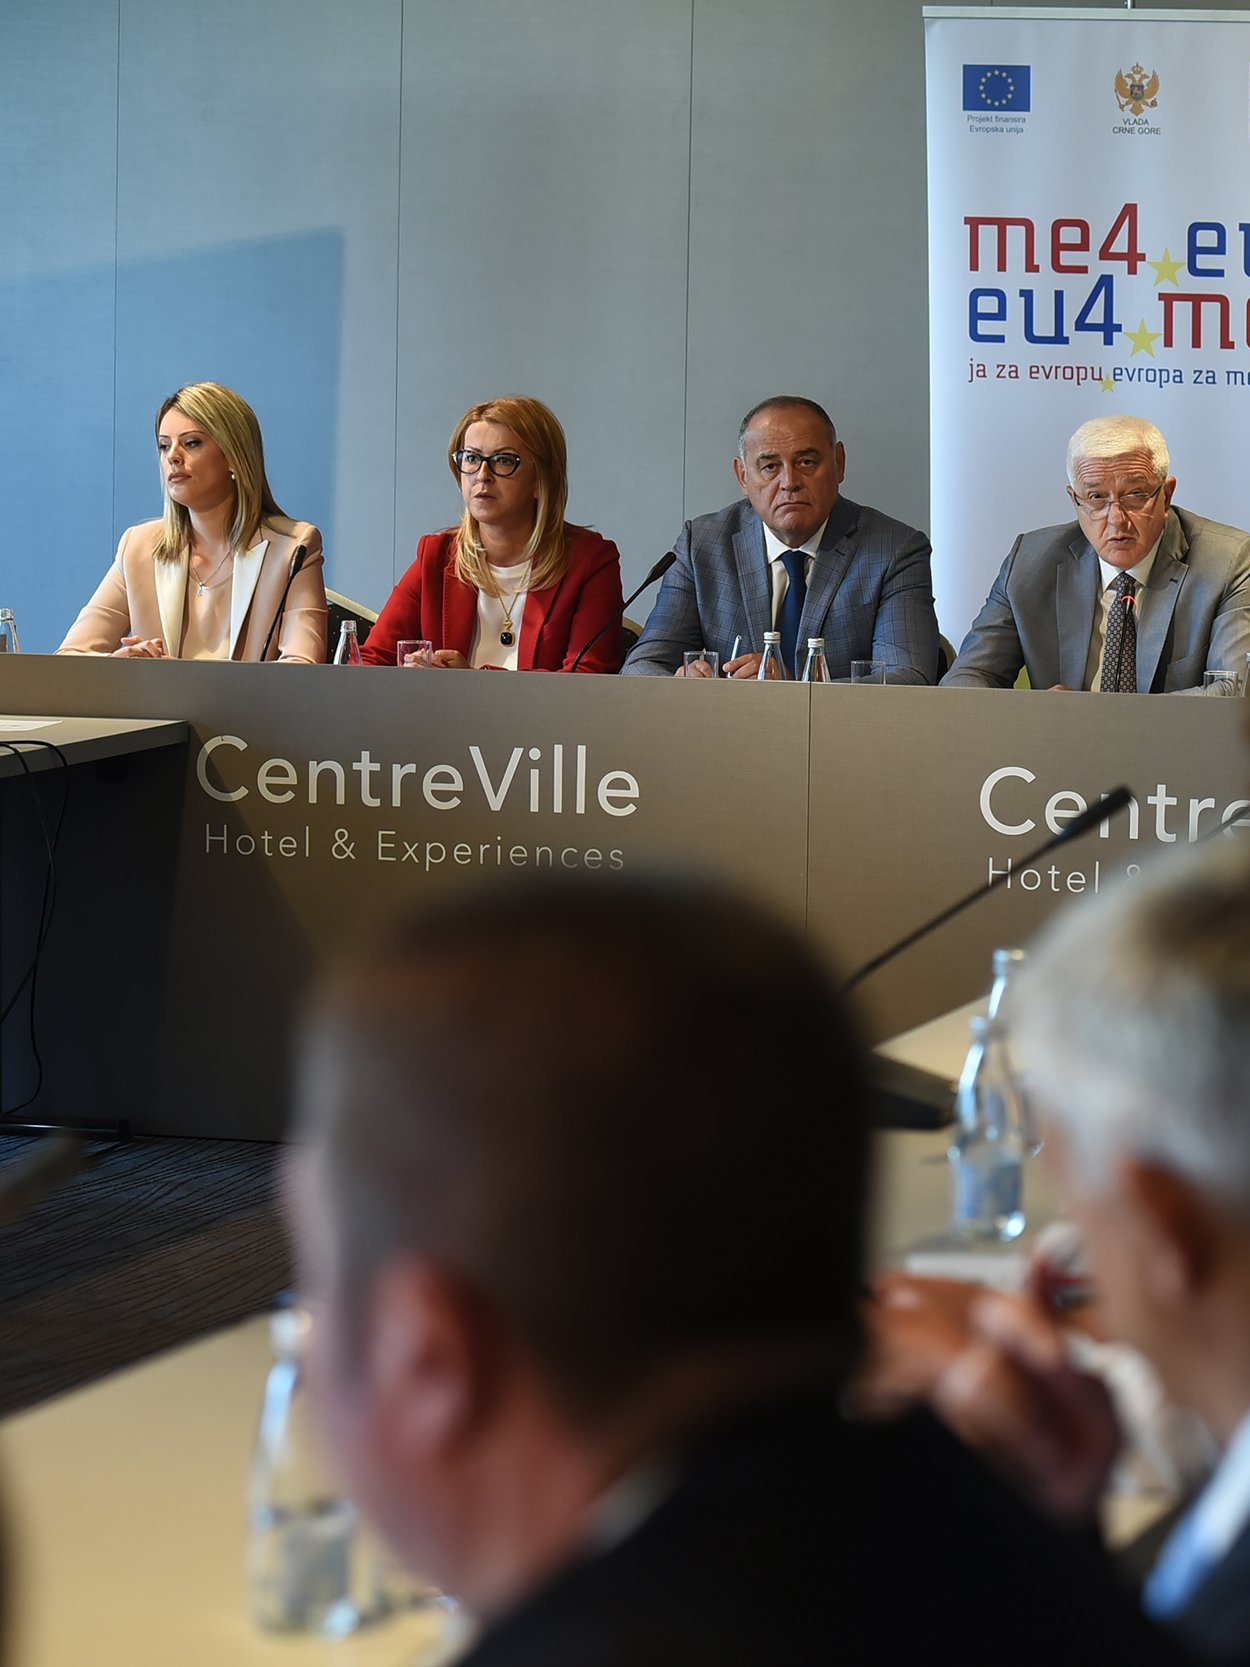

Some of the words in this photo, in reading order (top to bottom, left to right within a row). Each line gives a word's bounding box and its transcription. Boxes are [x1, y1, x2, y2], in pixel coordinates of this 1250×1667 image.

[967, 115, 993, 125] Projekt
[994, 115, 1027, 123] finansira
[969, 125, 1004, 134] Evropska
[1112, 126, 1135, 134] CRNE
[1137, 127, 1161, 135] GORE
[968, 358, 987, 383] ja
[997, 364, 1019, 379] za
[1030, 365, 1103, 385] evropu
[1113, 367, 1184, 388] evropa
[1193, 370, 1216, 384] za
[196, 735, 640, 817] CentreVille
[207, 824, 309, 857] Hotel
[332, 829, 355, 859] &
[379, 831, 623, 871] Experiences
[988, 856, 1100, 894] Hotel
